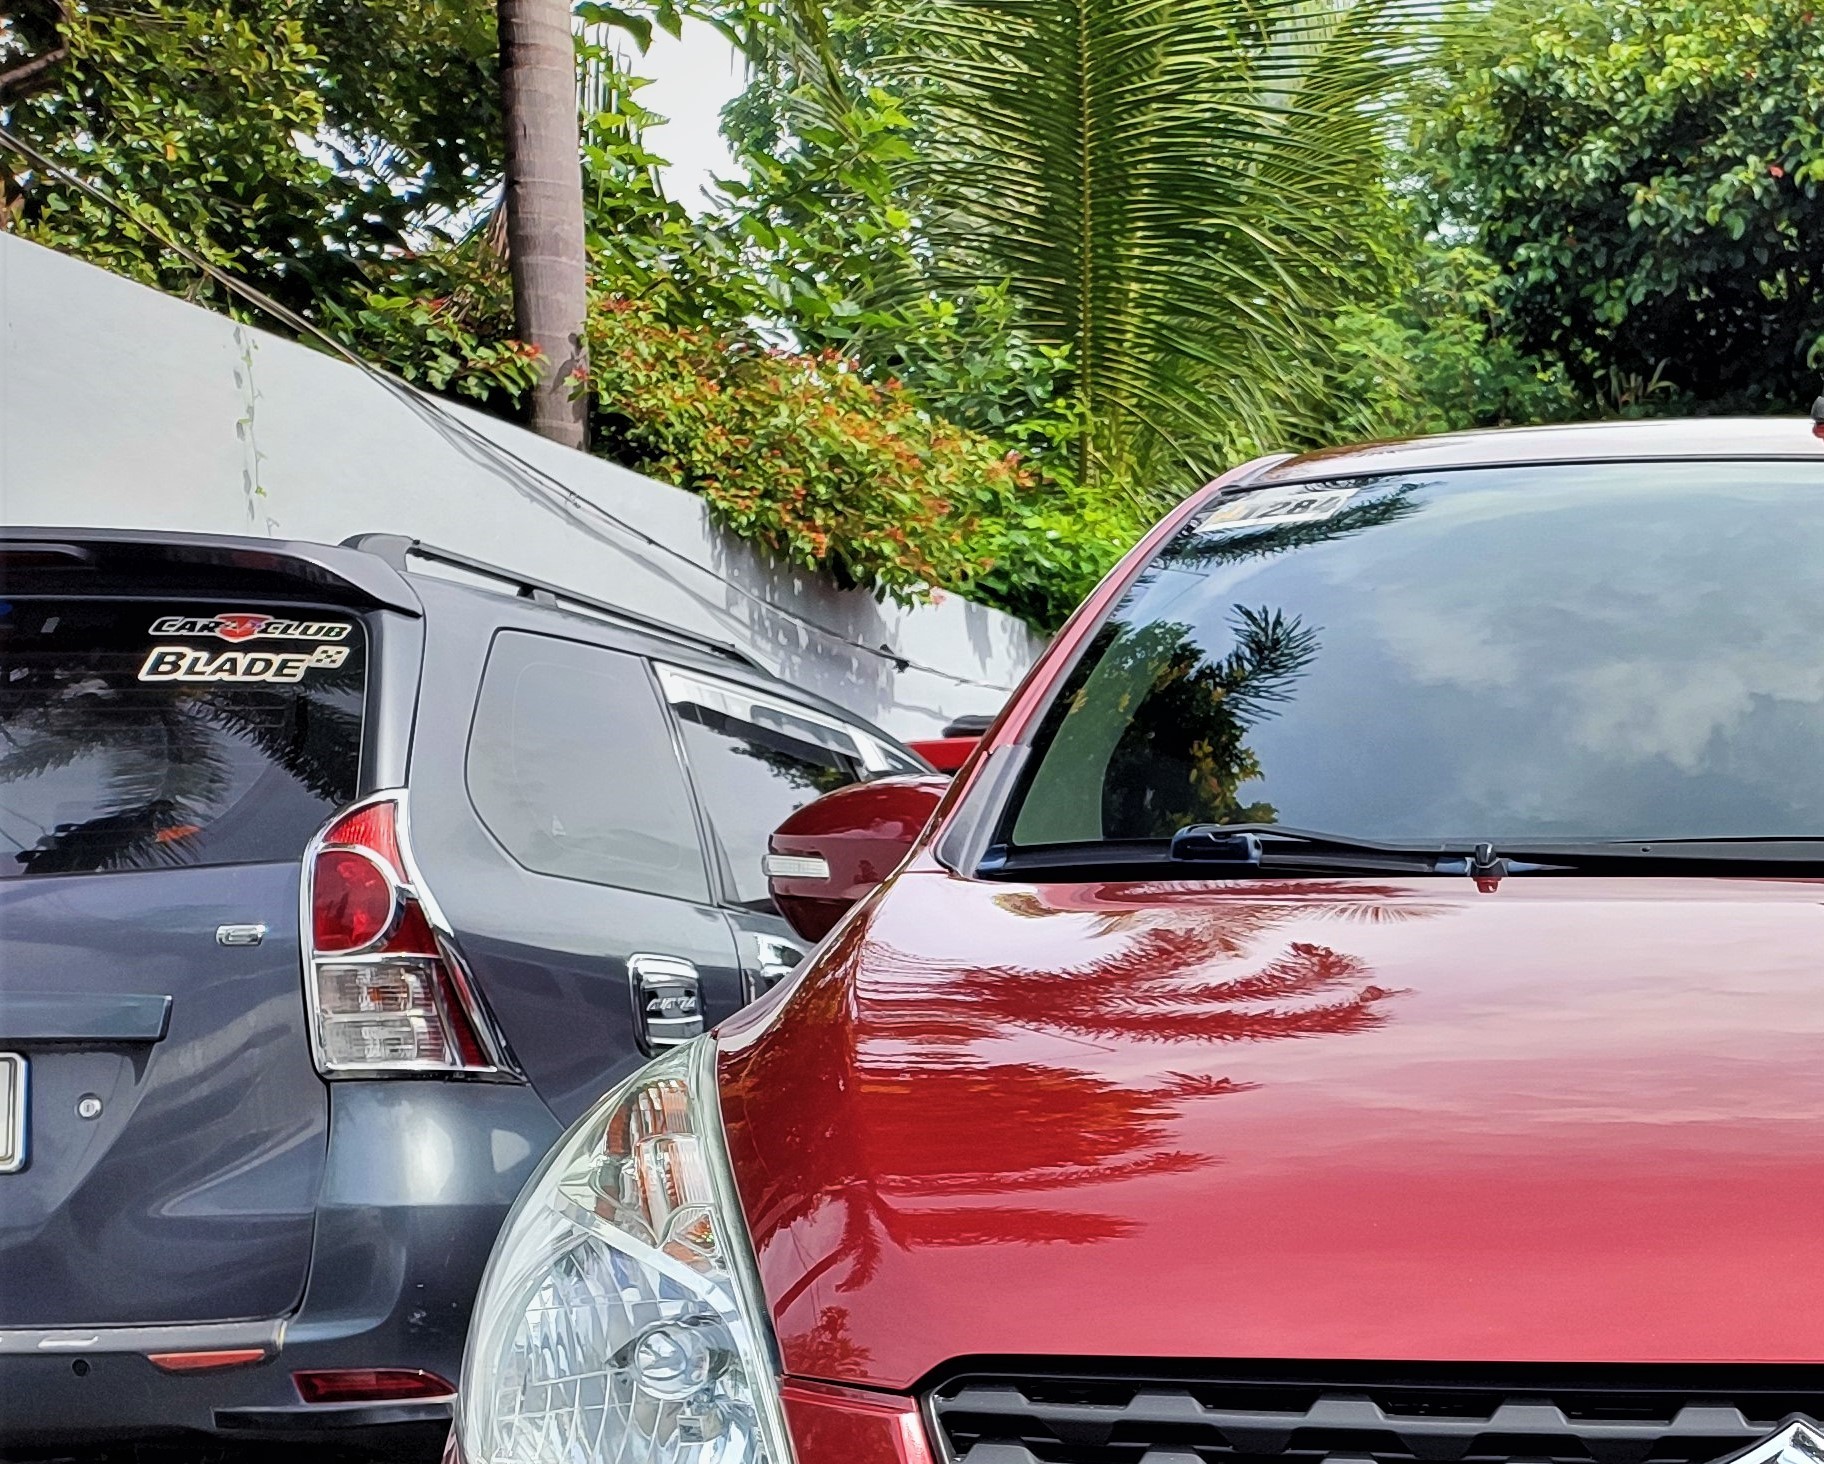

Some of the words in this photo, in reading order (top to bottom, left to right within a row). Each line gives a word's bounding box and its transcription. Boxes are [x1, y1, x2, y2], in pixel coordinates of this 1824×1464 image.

[150, 618, 222, 634] CAR
[258, 620, 349, 639] CLUB
[143, 649, 308, 680] BLADE
